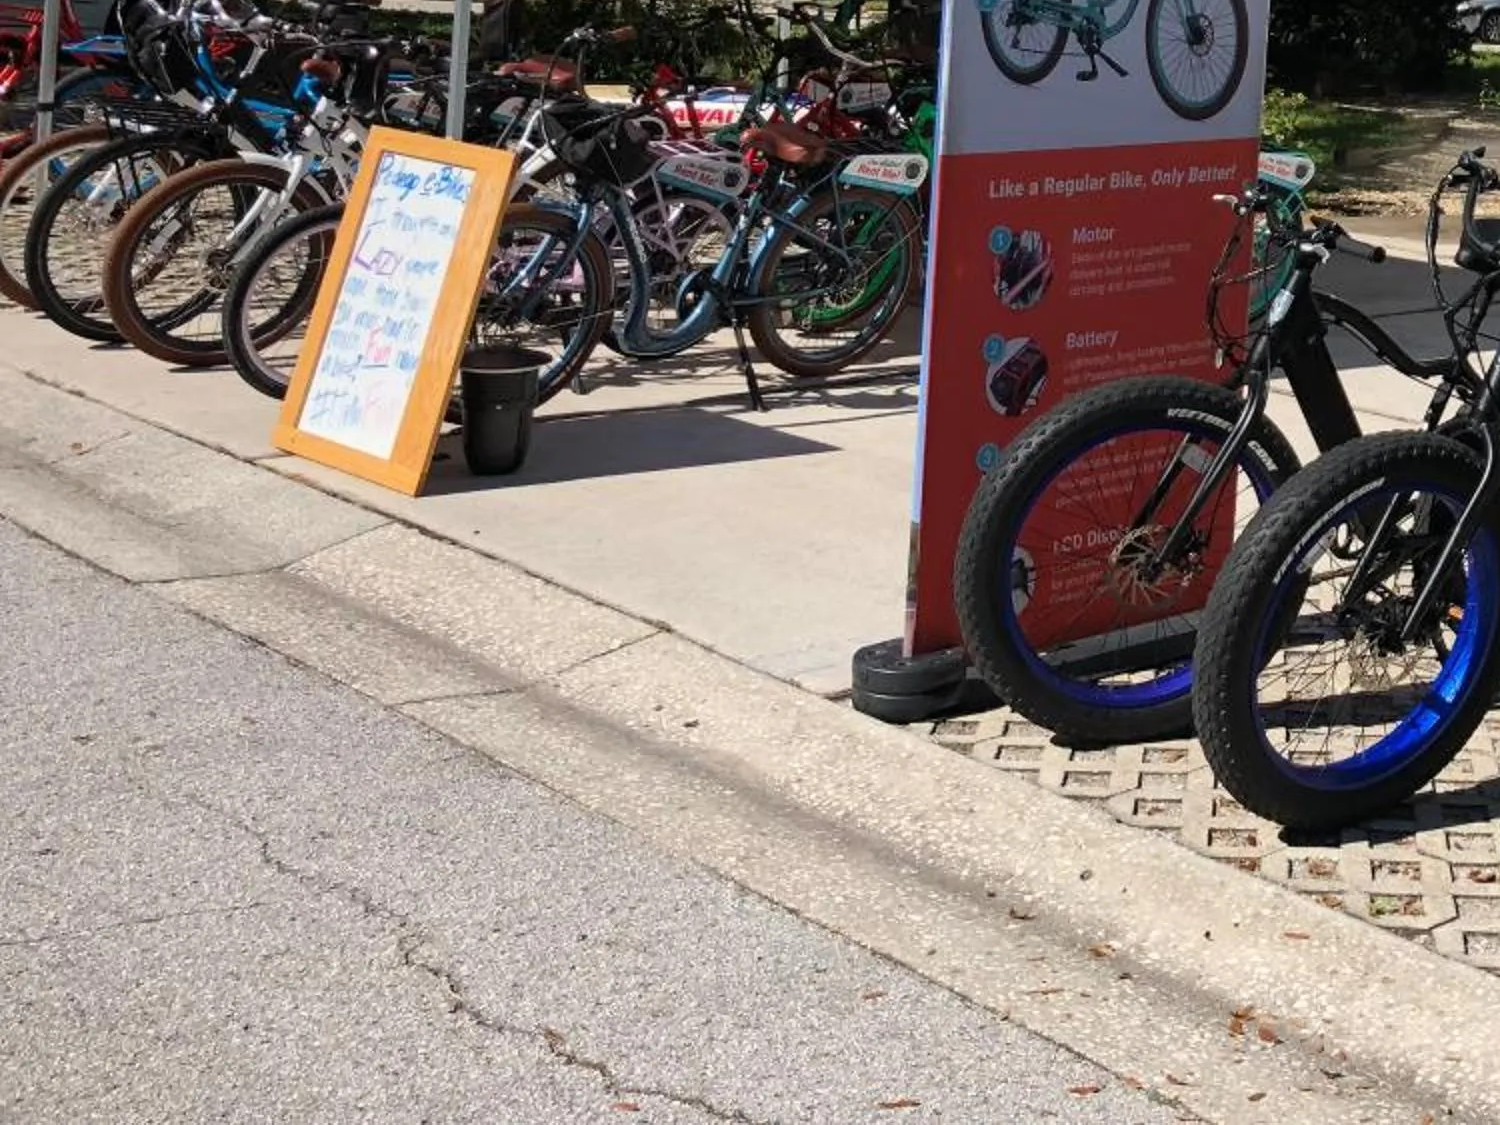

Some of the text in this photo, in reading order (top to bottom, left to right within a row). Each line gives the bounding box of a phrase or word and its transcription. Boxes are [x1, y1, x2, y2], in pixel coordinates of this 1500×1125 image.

[989, 178, 1025, 198] Like
[1028, 184, 1039, 196] a
[1043, 173, 1105, 197] Regular
[1109, 170, 1148, 190] Bike,
[1151, 167, 1185, 188] Only
[1187, 164, 1238, 183] Better!
[1072, 226, 1116, 244] Motor
[1066, 330, 1120, 349] Battery
